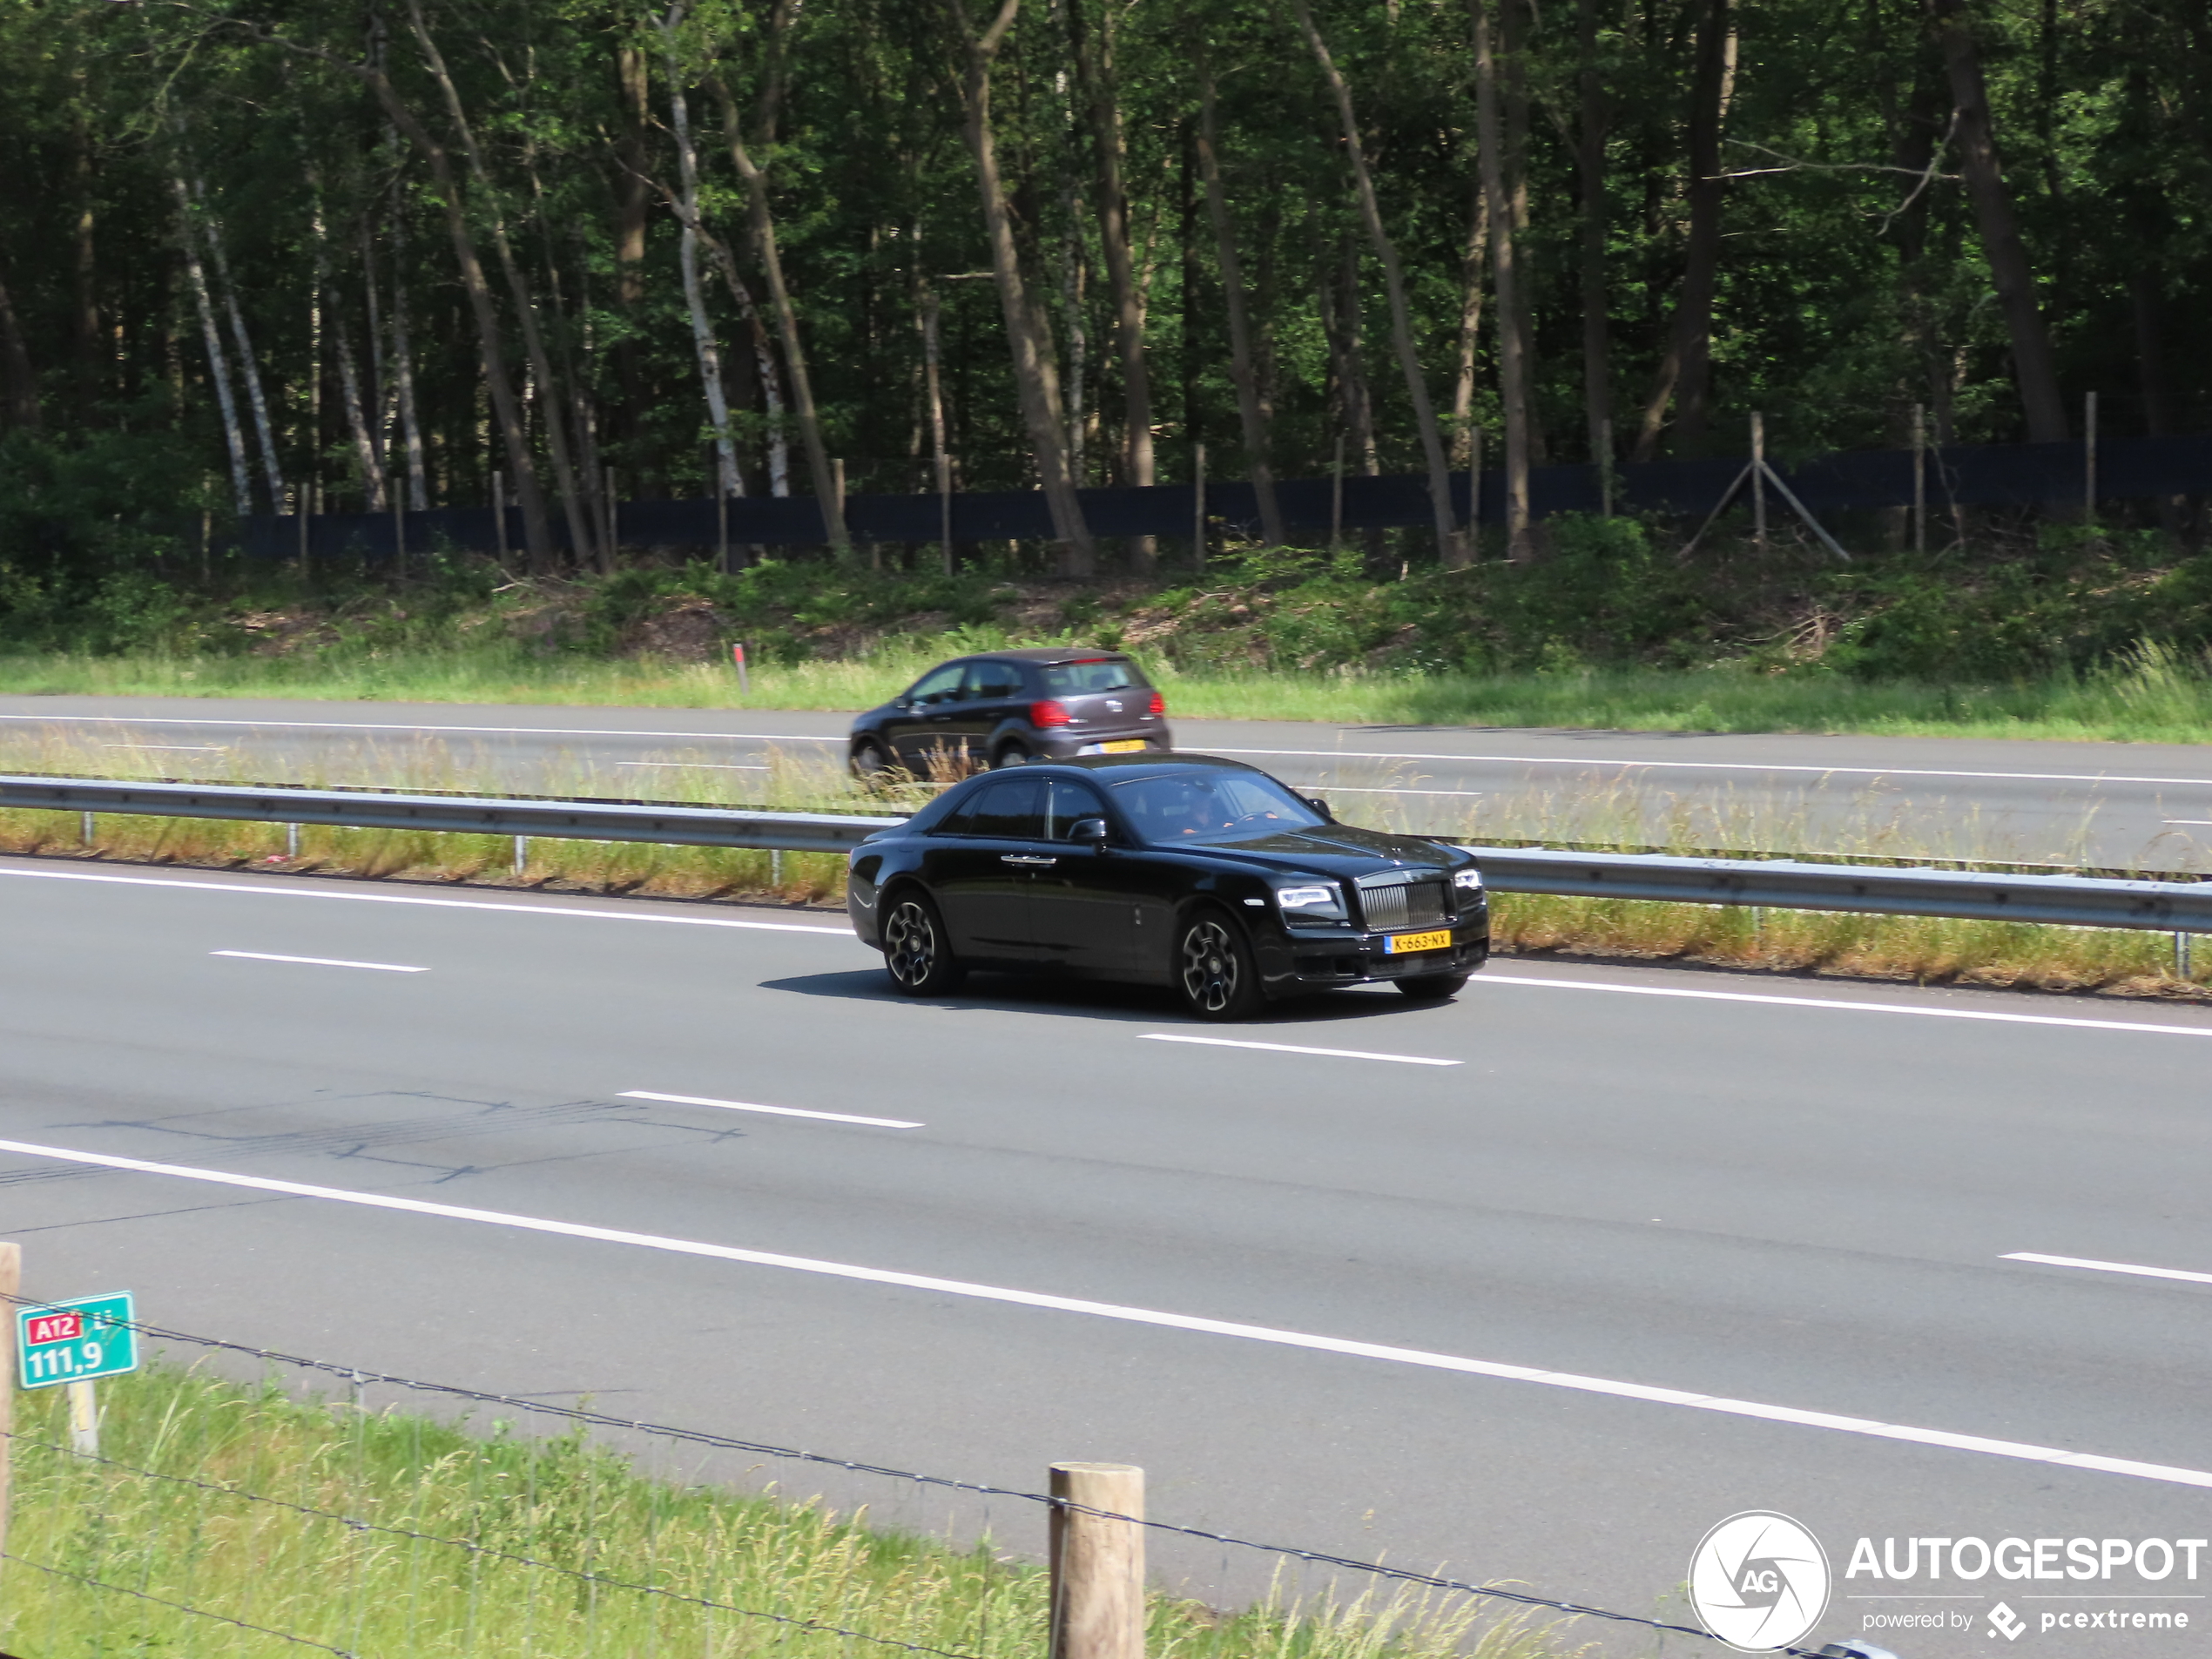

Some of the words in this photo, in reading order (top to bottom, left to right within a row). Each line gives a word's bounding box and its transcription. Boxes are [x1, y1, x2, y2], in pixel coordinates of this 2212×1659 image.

[1394, 932, 1447, 951] K-663-NX
[35, 1316, 76, 1340] A12
[27, 1342, 103, 1378] 111,9
